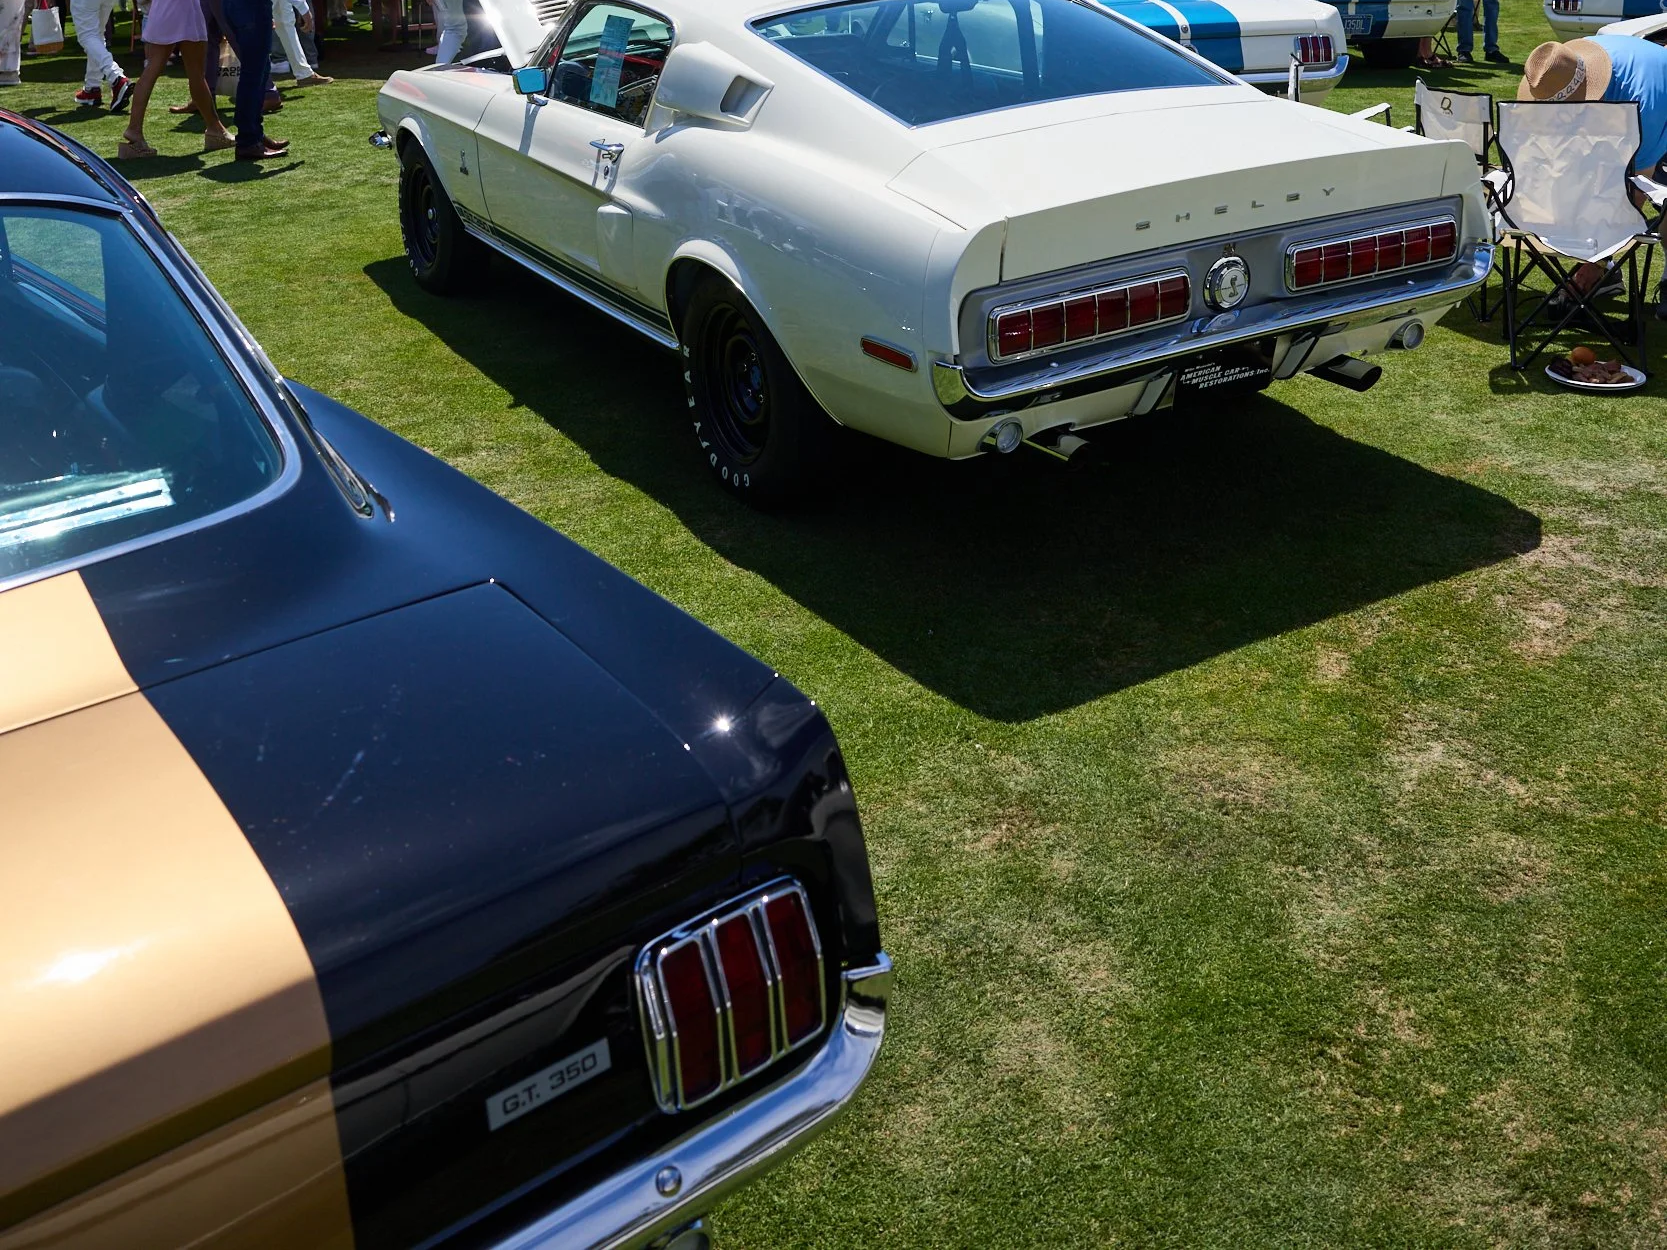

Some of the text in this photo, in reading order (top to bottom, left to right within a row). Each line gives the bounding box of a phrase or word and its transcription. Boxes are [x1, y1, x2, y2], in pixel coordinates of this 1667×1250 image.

[1135, 187, 1335, 231] SHELBY
[1180, 365, 1221, 381] AMERICAN
[1191, 371, 1222, 384] MUSCLE
[1224, 367, 1240, 376] CAR
[1199, 370, 1255, 389] RESTORATIONS
[682, 344, 750, 487] GOODYEAR
[502, 1052, 598, 1116] G.T. 350
